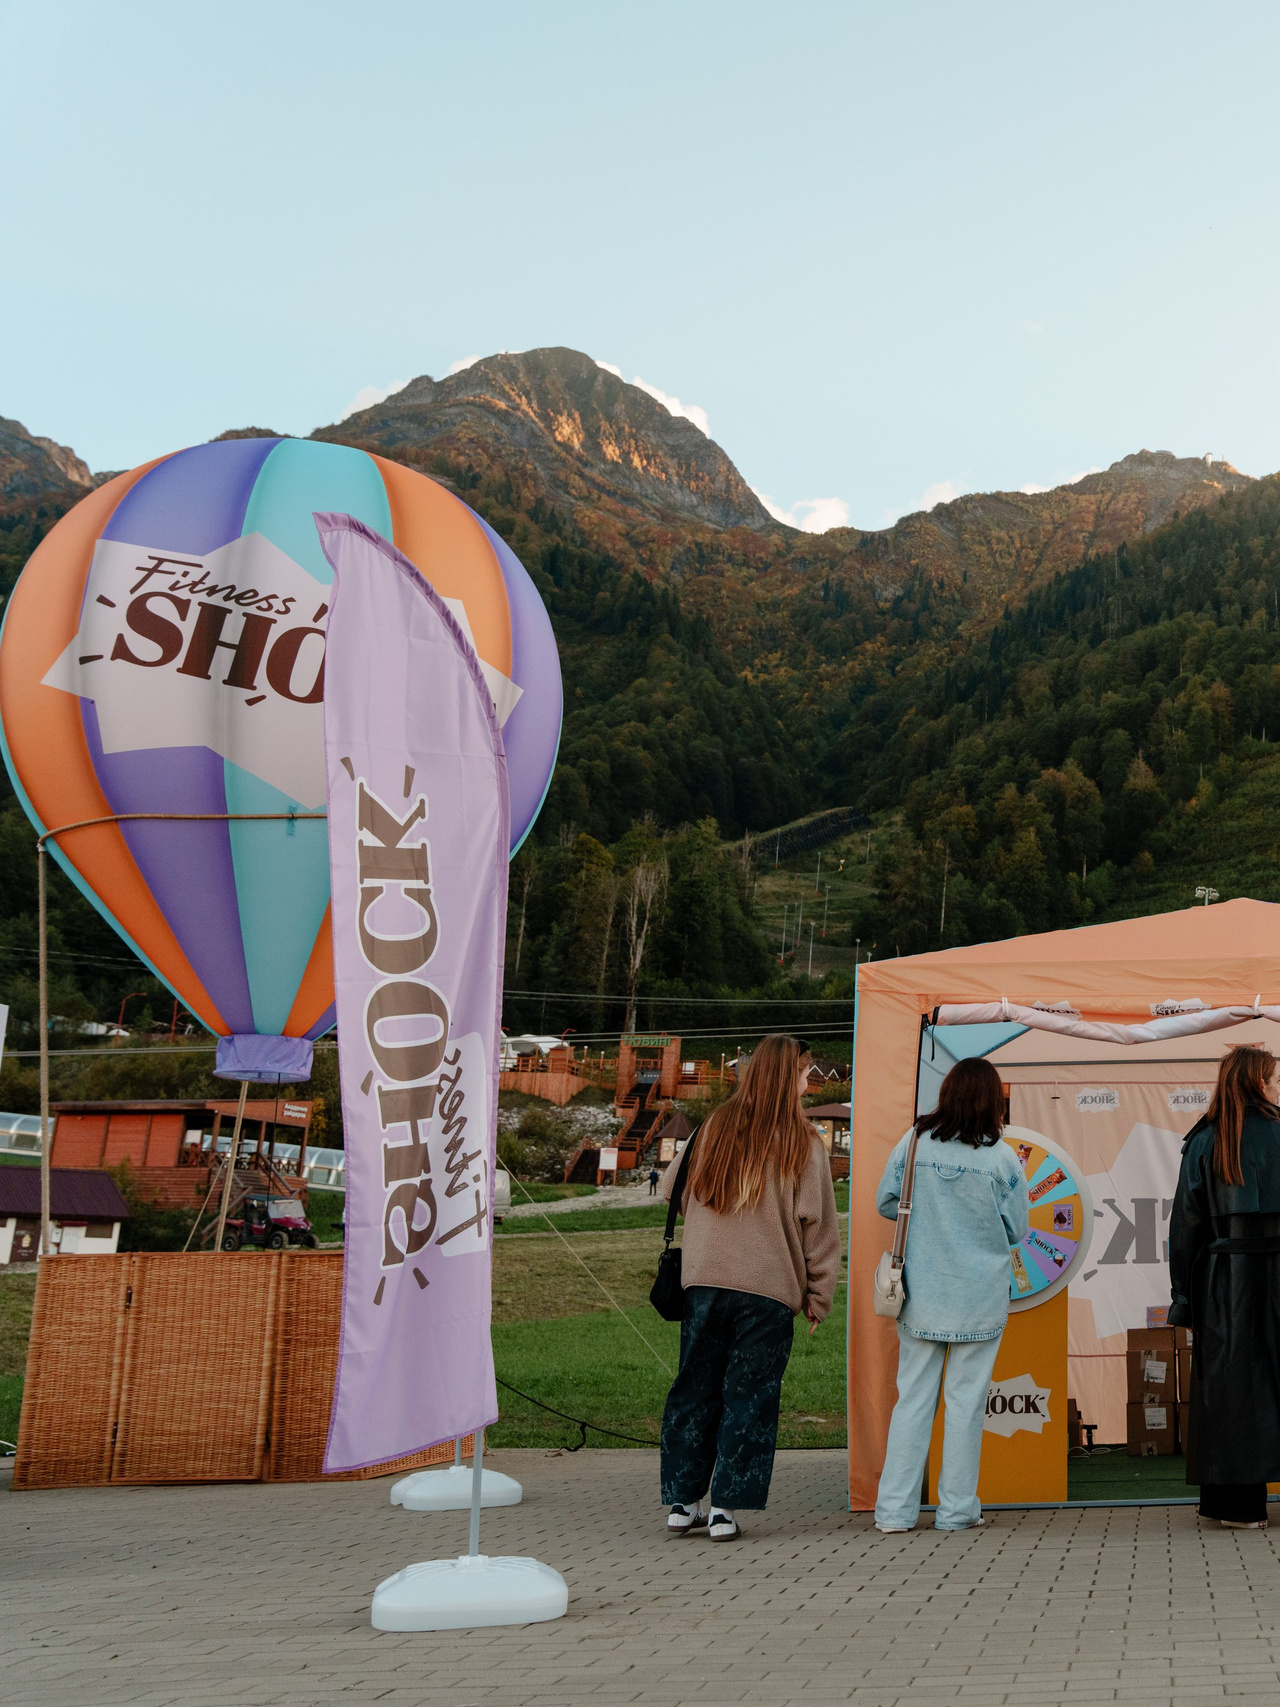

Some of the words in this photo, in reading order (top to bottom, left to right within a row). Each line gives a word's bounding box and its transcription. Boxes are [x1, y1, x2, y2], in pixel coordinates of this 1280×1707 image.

[129, 555, 297, 616] Fitness
[110, 590, 326, 704] SHO
[1031, 1178, 1053, 1197] SHOCK
[1034, 1236, 1055, 1257] SHOCK
